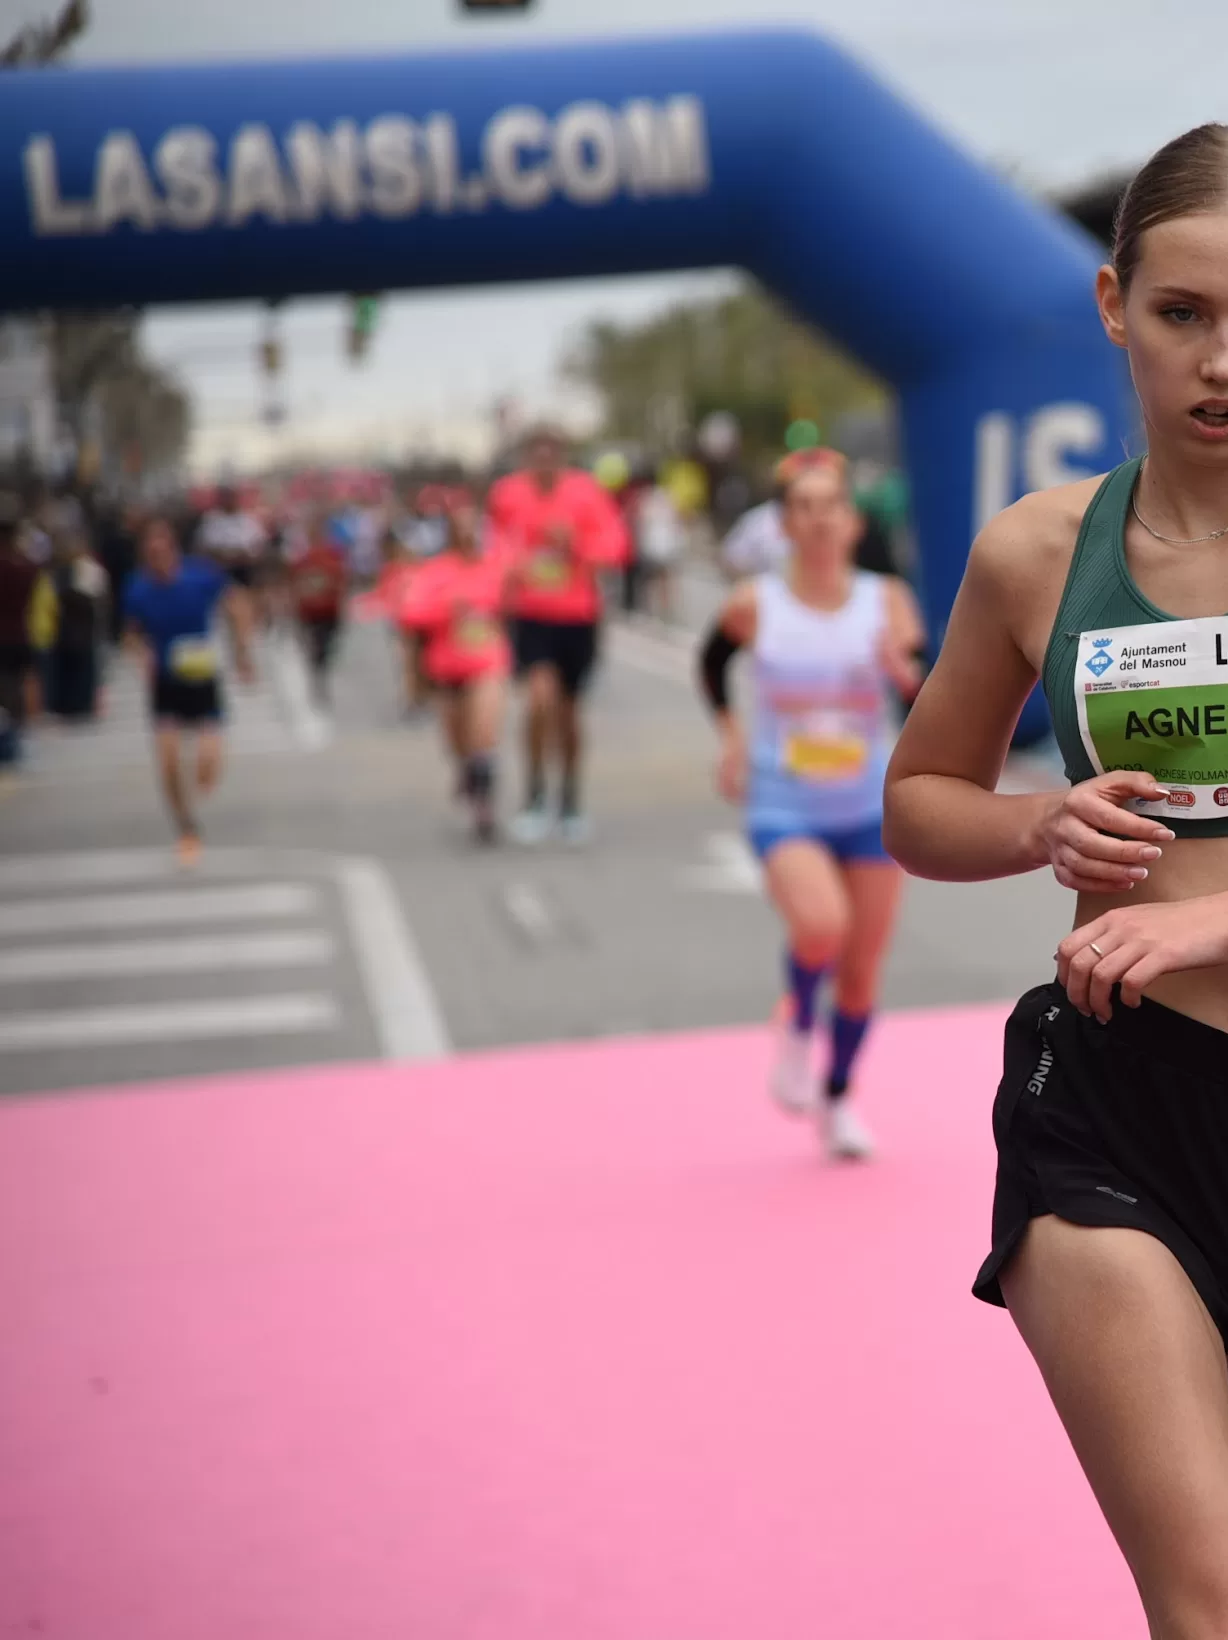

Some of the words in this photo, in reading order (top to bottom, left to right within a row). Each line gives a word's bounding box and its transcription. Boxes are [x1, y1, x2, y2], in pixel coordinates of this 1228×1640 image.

[24, 95, 710, 236] LASANSI.COM
[1120, 642, 1187, 659] Ajuntament
[1119, 659, 1137, 671] del
[1142, 658, 1187, 669] Masnou
[1129, 680, 1160, 689] esportcat
[1154, 768, 1186, 779] AGNESE
[1170, 794, 1191, 804] NOEL
[1027, 1006, 1060, 1096] RNING
